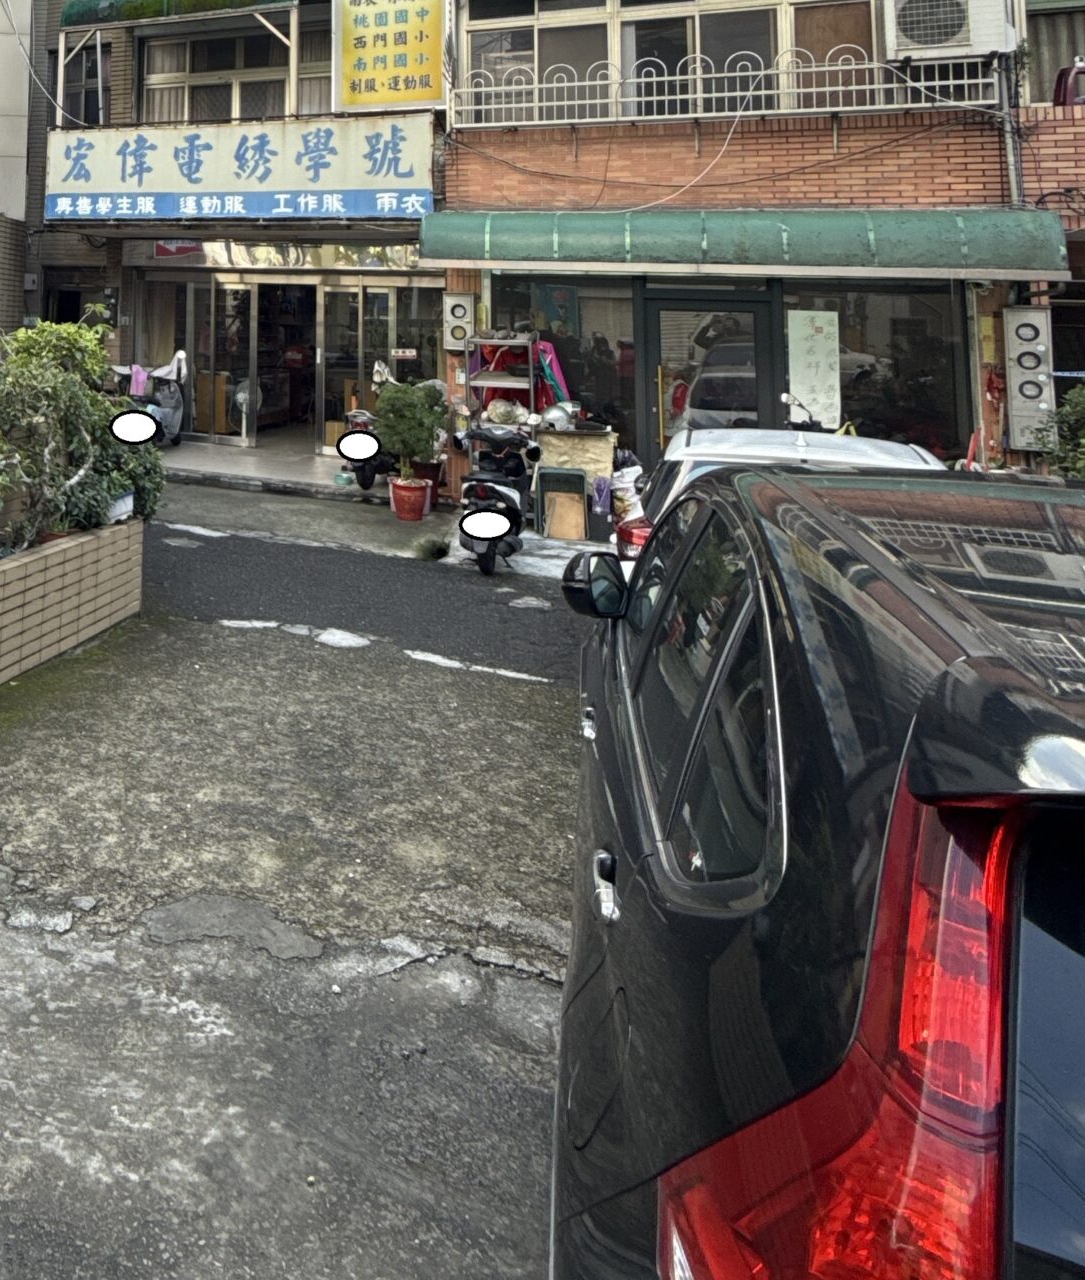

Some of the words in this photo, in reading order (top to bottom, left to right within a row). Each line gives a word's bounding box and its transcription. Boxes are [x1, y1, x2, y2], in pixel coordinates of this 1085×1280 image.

[353, 7, 430, 29] 桃園國中
[353, 30, 430, 49] 西門國小
[353, 53, 429, 72] 南門國小
[179, 195, 247, 214] 運動服
[272, 193, 347, 213] 工作服
[375, 192, 426, 213] 雨衣
